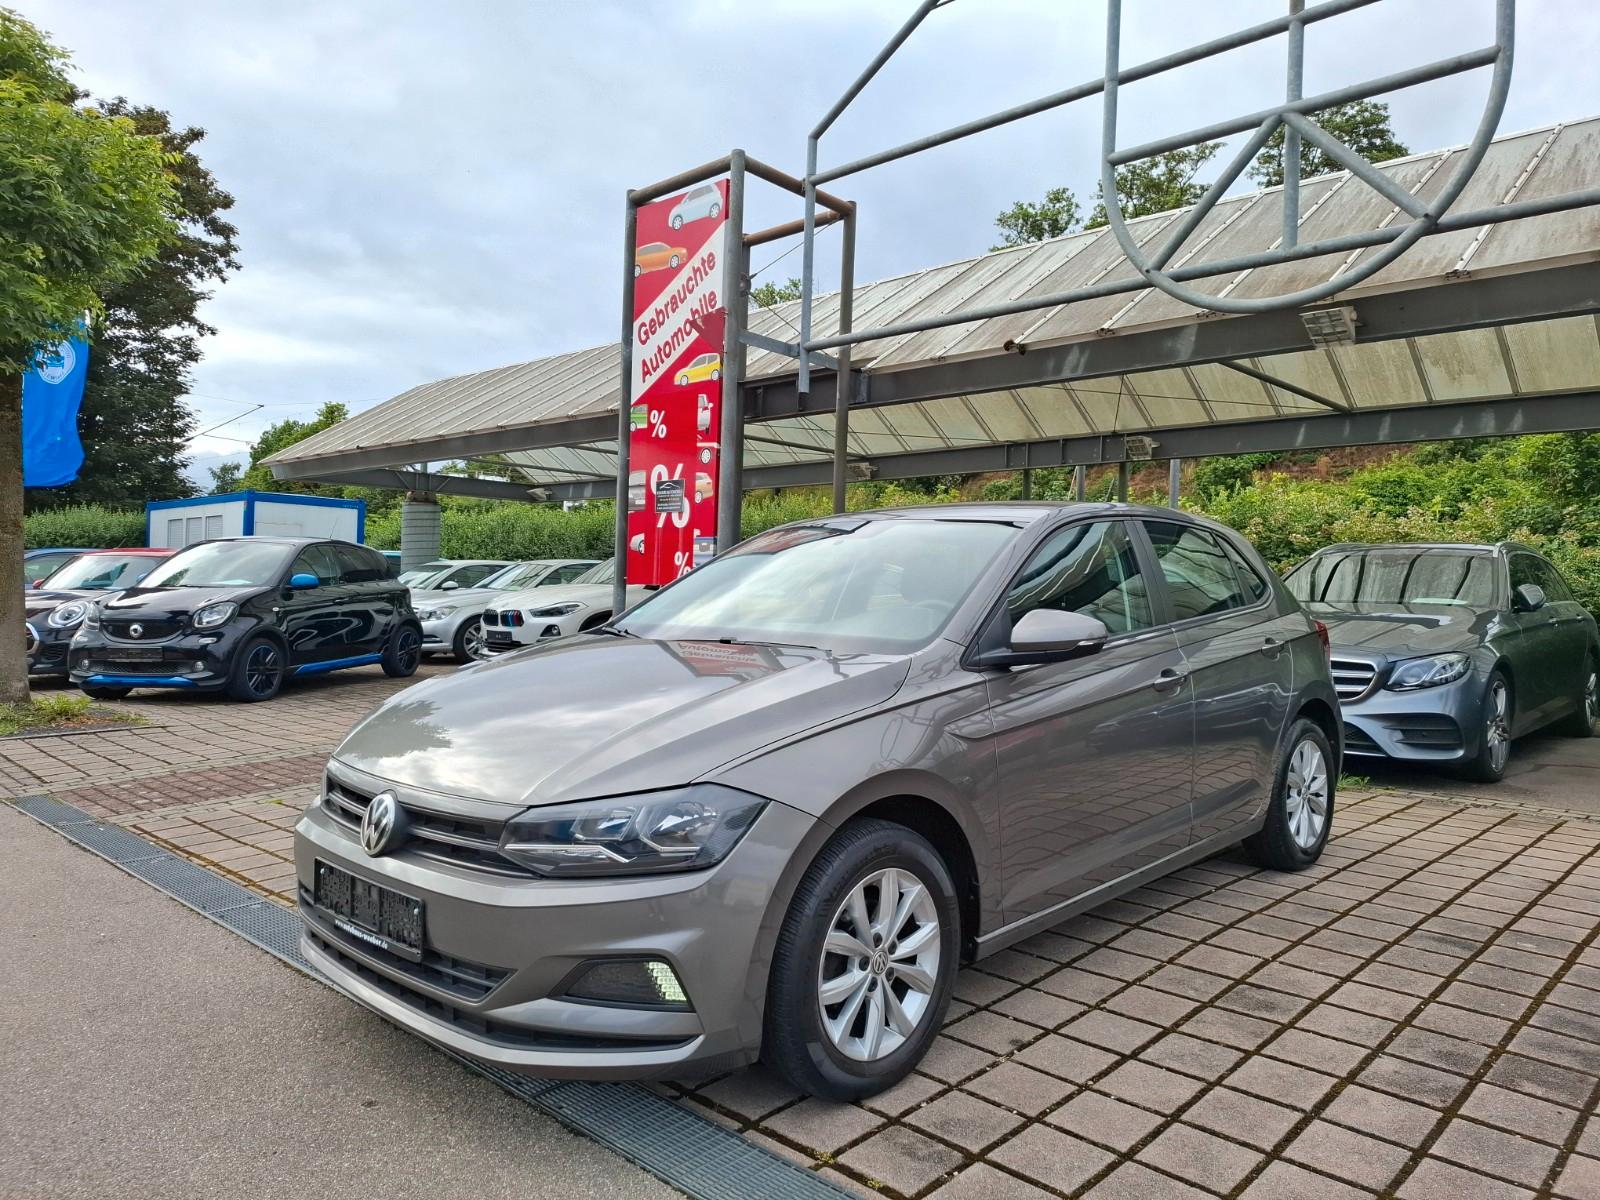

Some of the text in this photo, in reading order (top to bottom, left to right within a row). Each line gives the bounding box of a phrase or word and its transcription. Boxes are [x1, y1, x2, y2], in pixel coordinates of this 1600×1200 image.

[637, 251, 716, 346] Gebrauchte
[641, 290, 718, 383] Automobile
[650, 410, 667, 438] %
